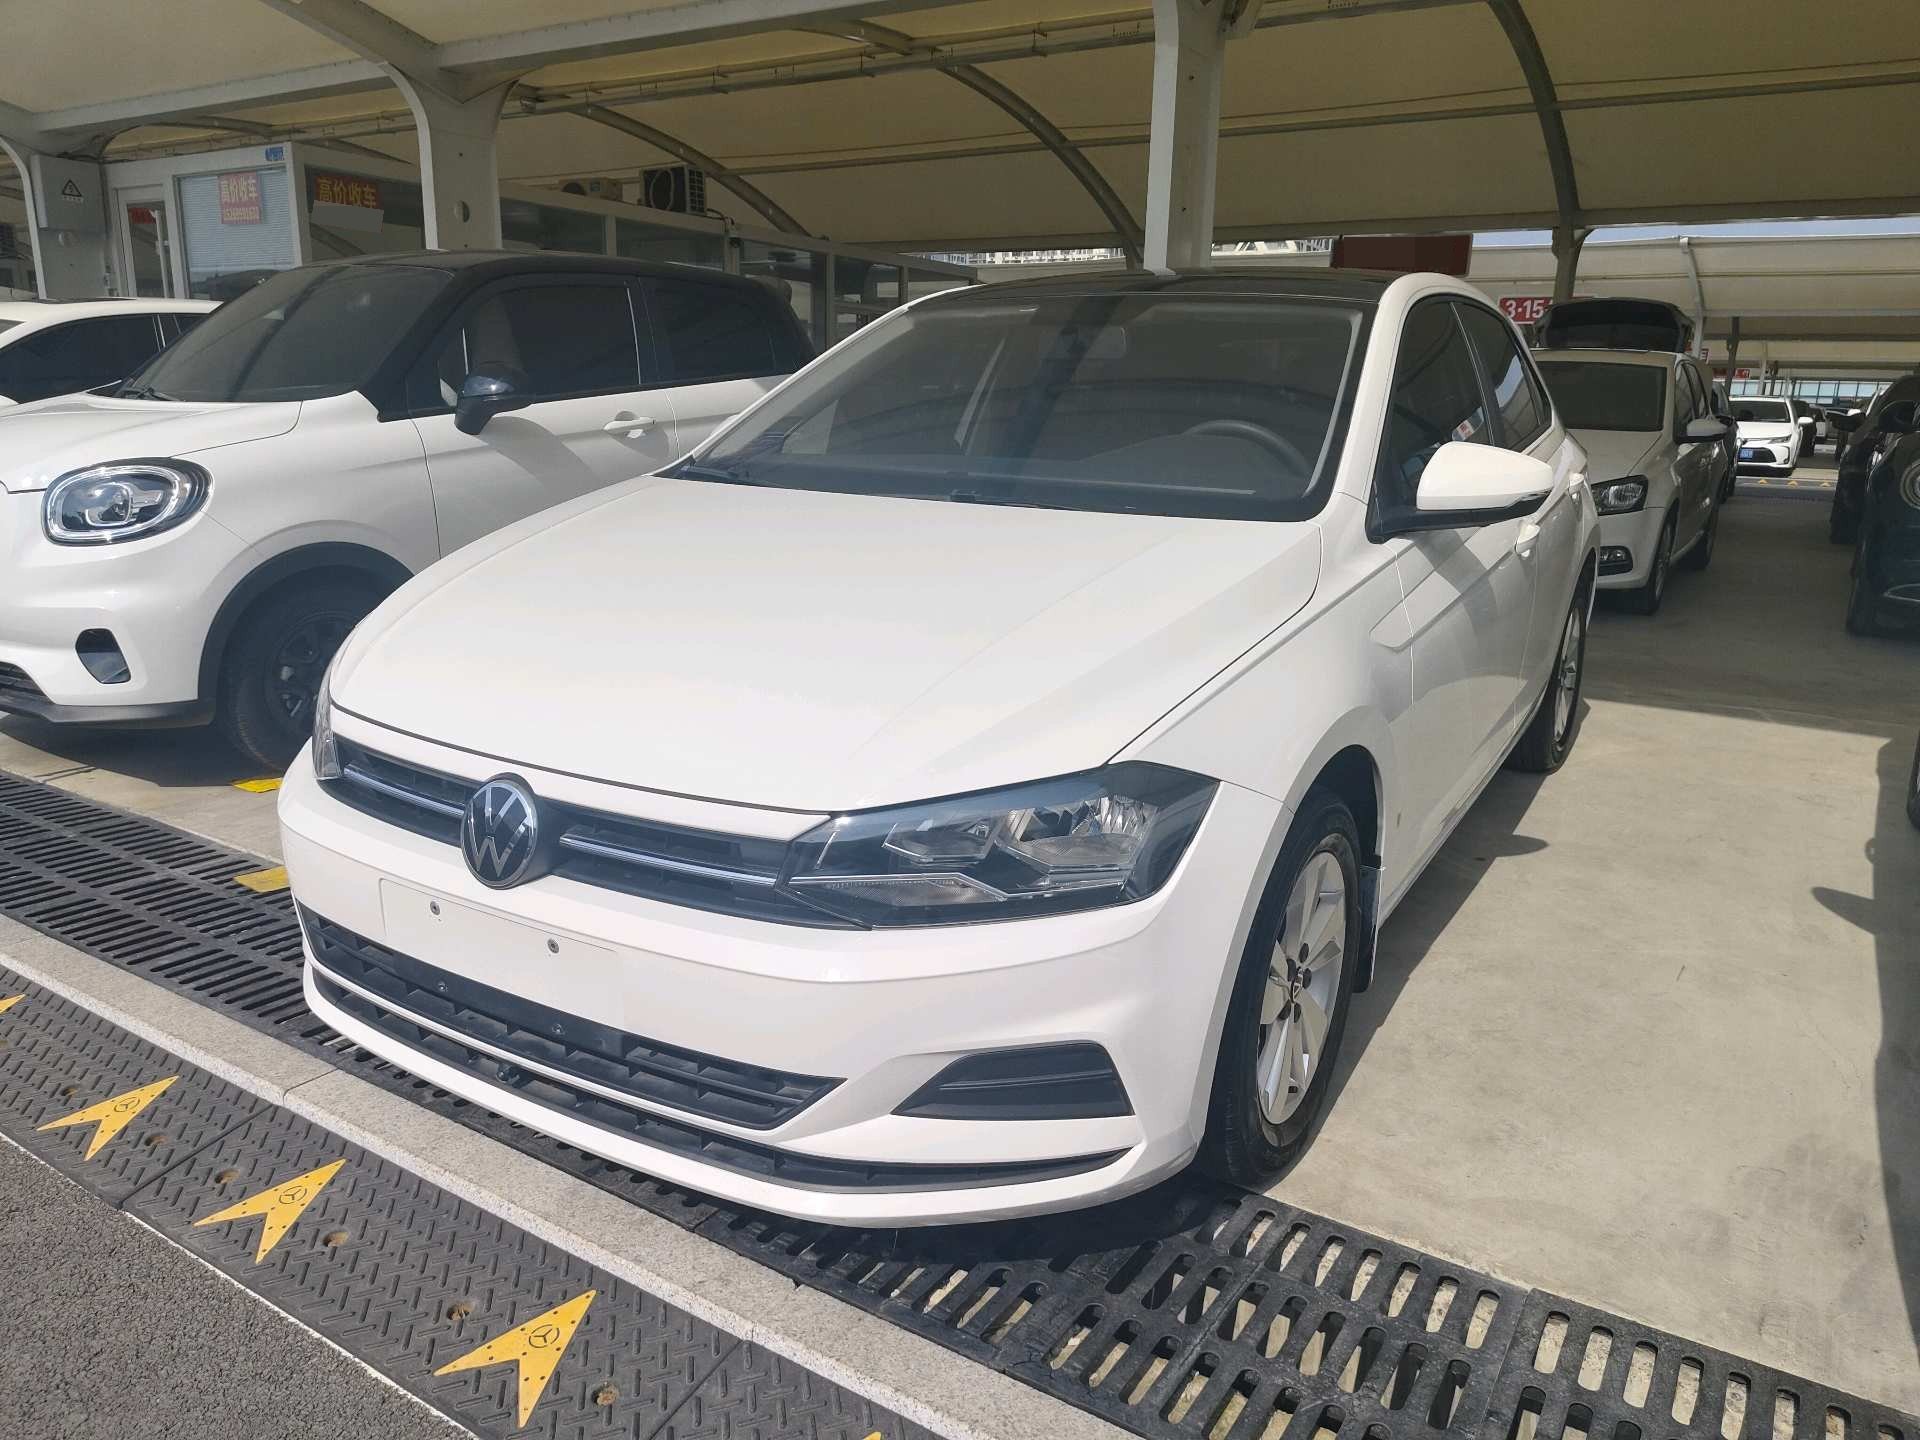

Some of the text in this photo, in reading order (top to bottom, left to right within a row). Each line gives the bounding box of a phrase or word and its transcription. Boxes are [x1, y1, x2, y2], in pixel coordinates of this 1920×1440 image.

[220, 175, 258, 202] 高价收车
[318, 175, 377, 208] 高价收车
